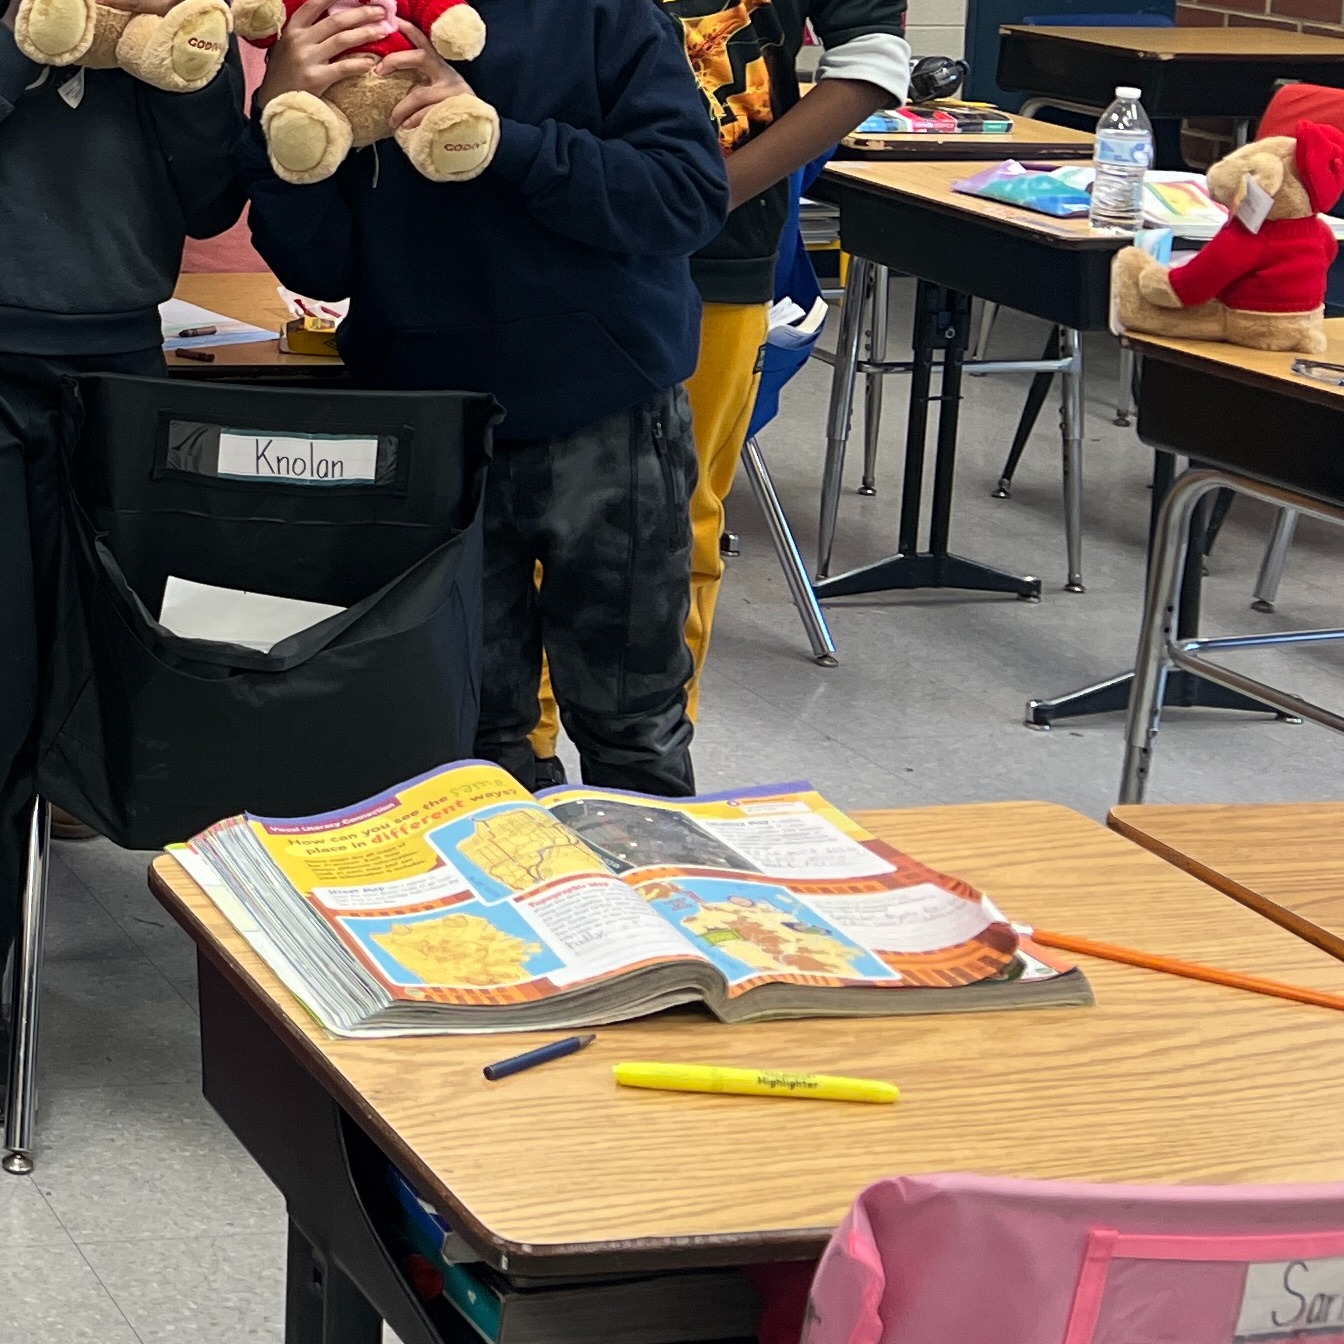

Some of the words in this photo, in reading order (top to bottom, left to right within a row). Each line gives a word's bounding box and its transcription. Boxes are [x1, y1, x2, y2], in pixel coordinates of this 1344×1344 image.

[255, 439, 344, 478] Knolan
[288, 837, 325, 847] How
[329, 833, 358, 845] can
[363, 821, 390, 839] you
[394, 809, 420, 825] see
[422, 795, 448, 811] the
[301, 821, 340, 834] Literacy
[342, 803, 396, 827] Connection
[305, 844, 347, 856] place
[351, 840, 368, 849] in
[371, 799, 465, 844] different
[469, 789, 518, 803] ways?
[758, 1075, 819, 1090] Highlighter
